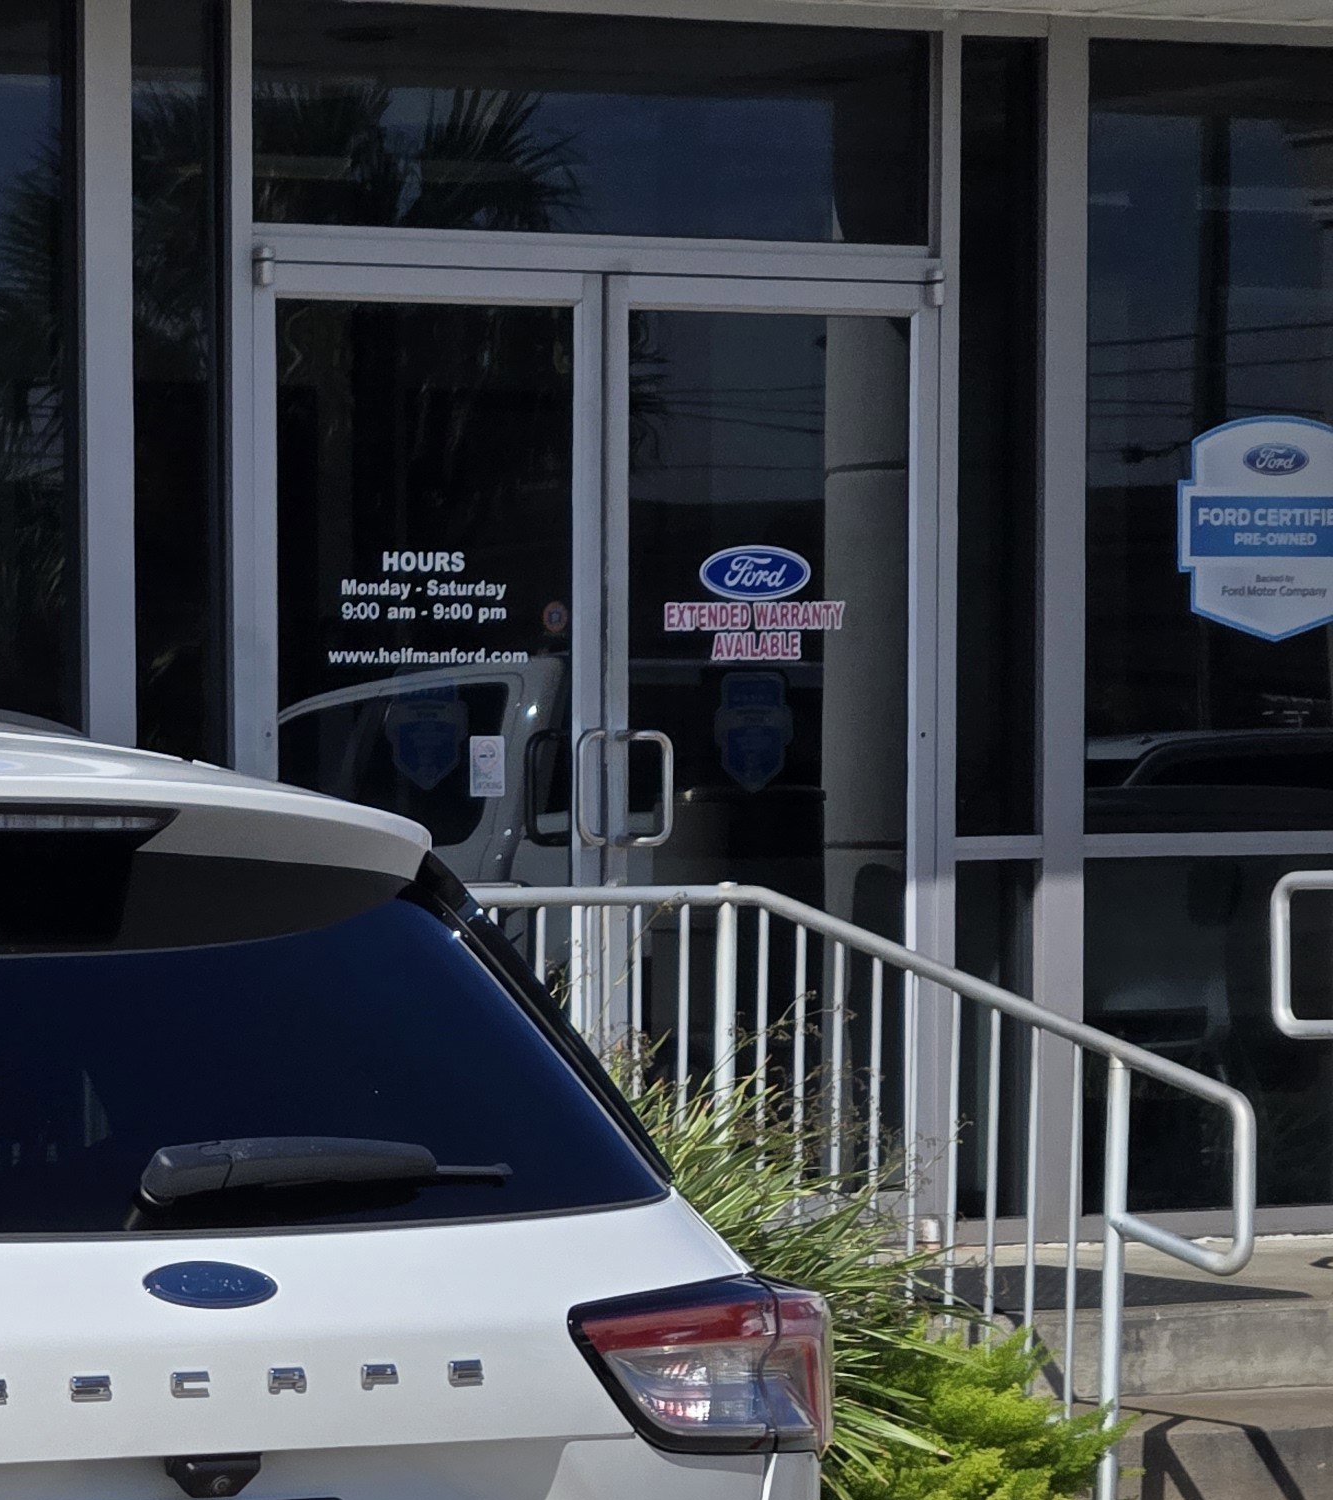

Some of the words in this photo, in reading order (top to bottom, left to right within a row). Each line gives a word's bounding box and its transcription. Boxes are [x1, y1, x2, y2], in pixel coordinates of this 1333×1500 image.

[1255, 448, 1298, 470] Ford
[1198, 507, 1249, 526] FORD
[1234, 532, 1317, 546] PRE-OWNED
[383, 551, 465, 572] HOURS
[724, 555, 788, 587] Ford
[341, 579, 411, 600] Monday
[426, 580, 507, 600] Saturday
[1221, 586, 1246, 597] Ford
[1247, 586, 1277, 597] Motor
[1279, 586, 1327, 598] Company
[341, 602, 380, 620] 9:00
[387, 606, 416, 619] am
[433, 603, 473, 620] 9:00
[478, 607, 507, 623] pm
[665, 603, 751, 630] EXTENDED
[754, 602, 844, 629] WARRANTY
[328, 648, 528, 664] www.helfmanford.com
[712, 632, 801, 660] AVAILABLE
